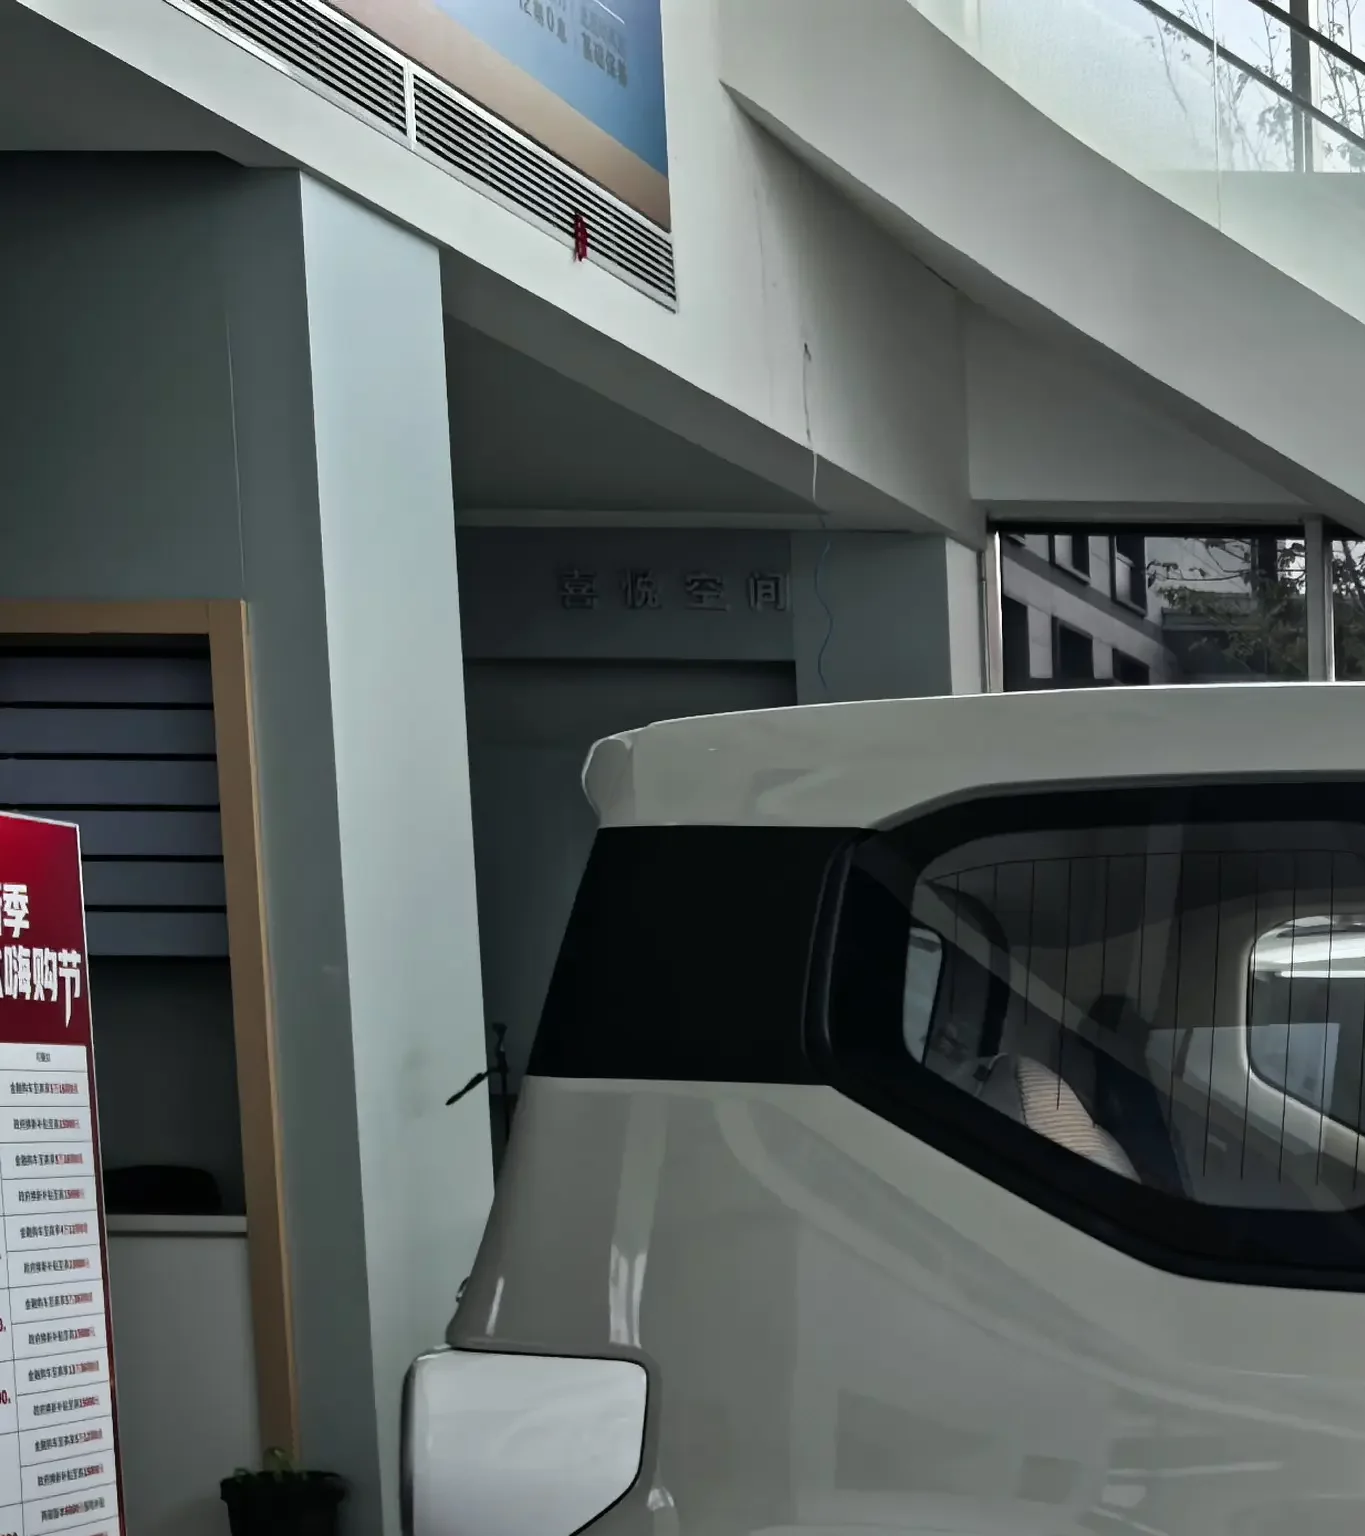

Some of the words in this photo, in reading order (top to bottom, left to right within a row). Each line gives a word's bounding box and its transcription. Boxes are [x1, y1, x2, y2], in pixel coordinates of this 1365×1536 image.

[561, 569, 791, 612] 喜悦空间
[0, 883, 30, 938] 季
[0, 945, 82, 1028] 嗨购节
